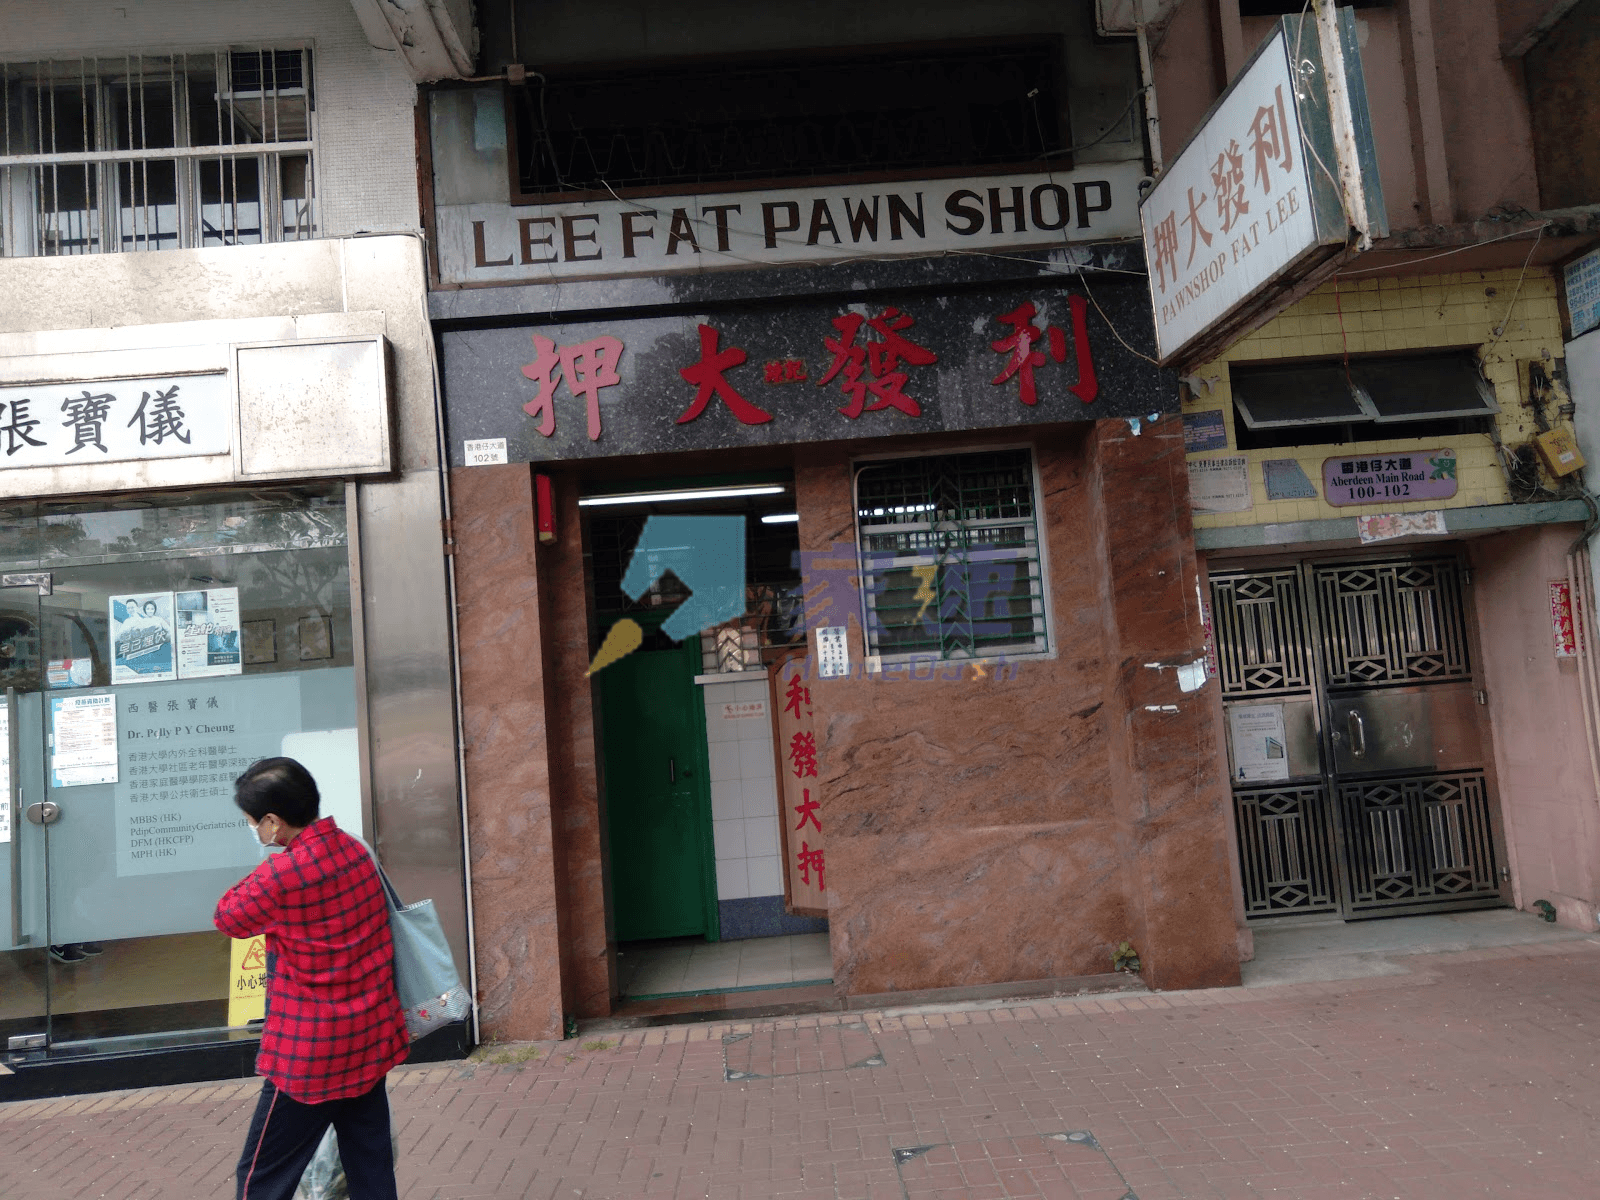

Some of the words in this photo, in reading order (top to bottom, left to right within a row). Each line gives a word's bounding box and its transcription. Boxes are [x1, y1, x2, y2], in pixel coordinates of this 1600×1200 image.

[472, 213, 602, 267] LEE
[619, 204, 741, 258] FAT
[761, 192, 926, 249] PAWN
[944, 180, 1112, 235] SHOP
[1161, 256, 1226, 325] PAWNSHOP
[1231, 228, 1260, 266] FAT
[1267, 186, 1301, 236] LEE
[0, 385, 191, 456] 張寶儀
[466, 441, 505, 452] 香港仔大道
[474, 453, 499, 463] 102號
[1341, 458, 1412, 474] 香港仔大道
[1330, 475, 1374, 487] Aberdeen
[1375, 473, 1399, 484] Main
[1401, 471, 1425, 482] Road
[1348, 484, 1410, 500] 100-102
[128, 695, 219, 714] 西醫張寶儀
[127, 730, 144, 739] Dr.
[175, 726, 182, 735] P
[184, 725, 193, 735] Y
[195, 724, 235, 734] Cheung
[784, 673, 825, 892] 利發大押
[130, 815, 158, 825] MBBS
[160, 813, 182, 822] (HK)
[130, 820, 236, 836] PdipCommunityGeriatrics
[130, 838, 152, 848] DFM
[154, 835, 194, 847] (HKCFP)
[131, 850, 153, 859] MPH
[155, 848, 177, 858] (HK)
